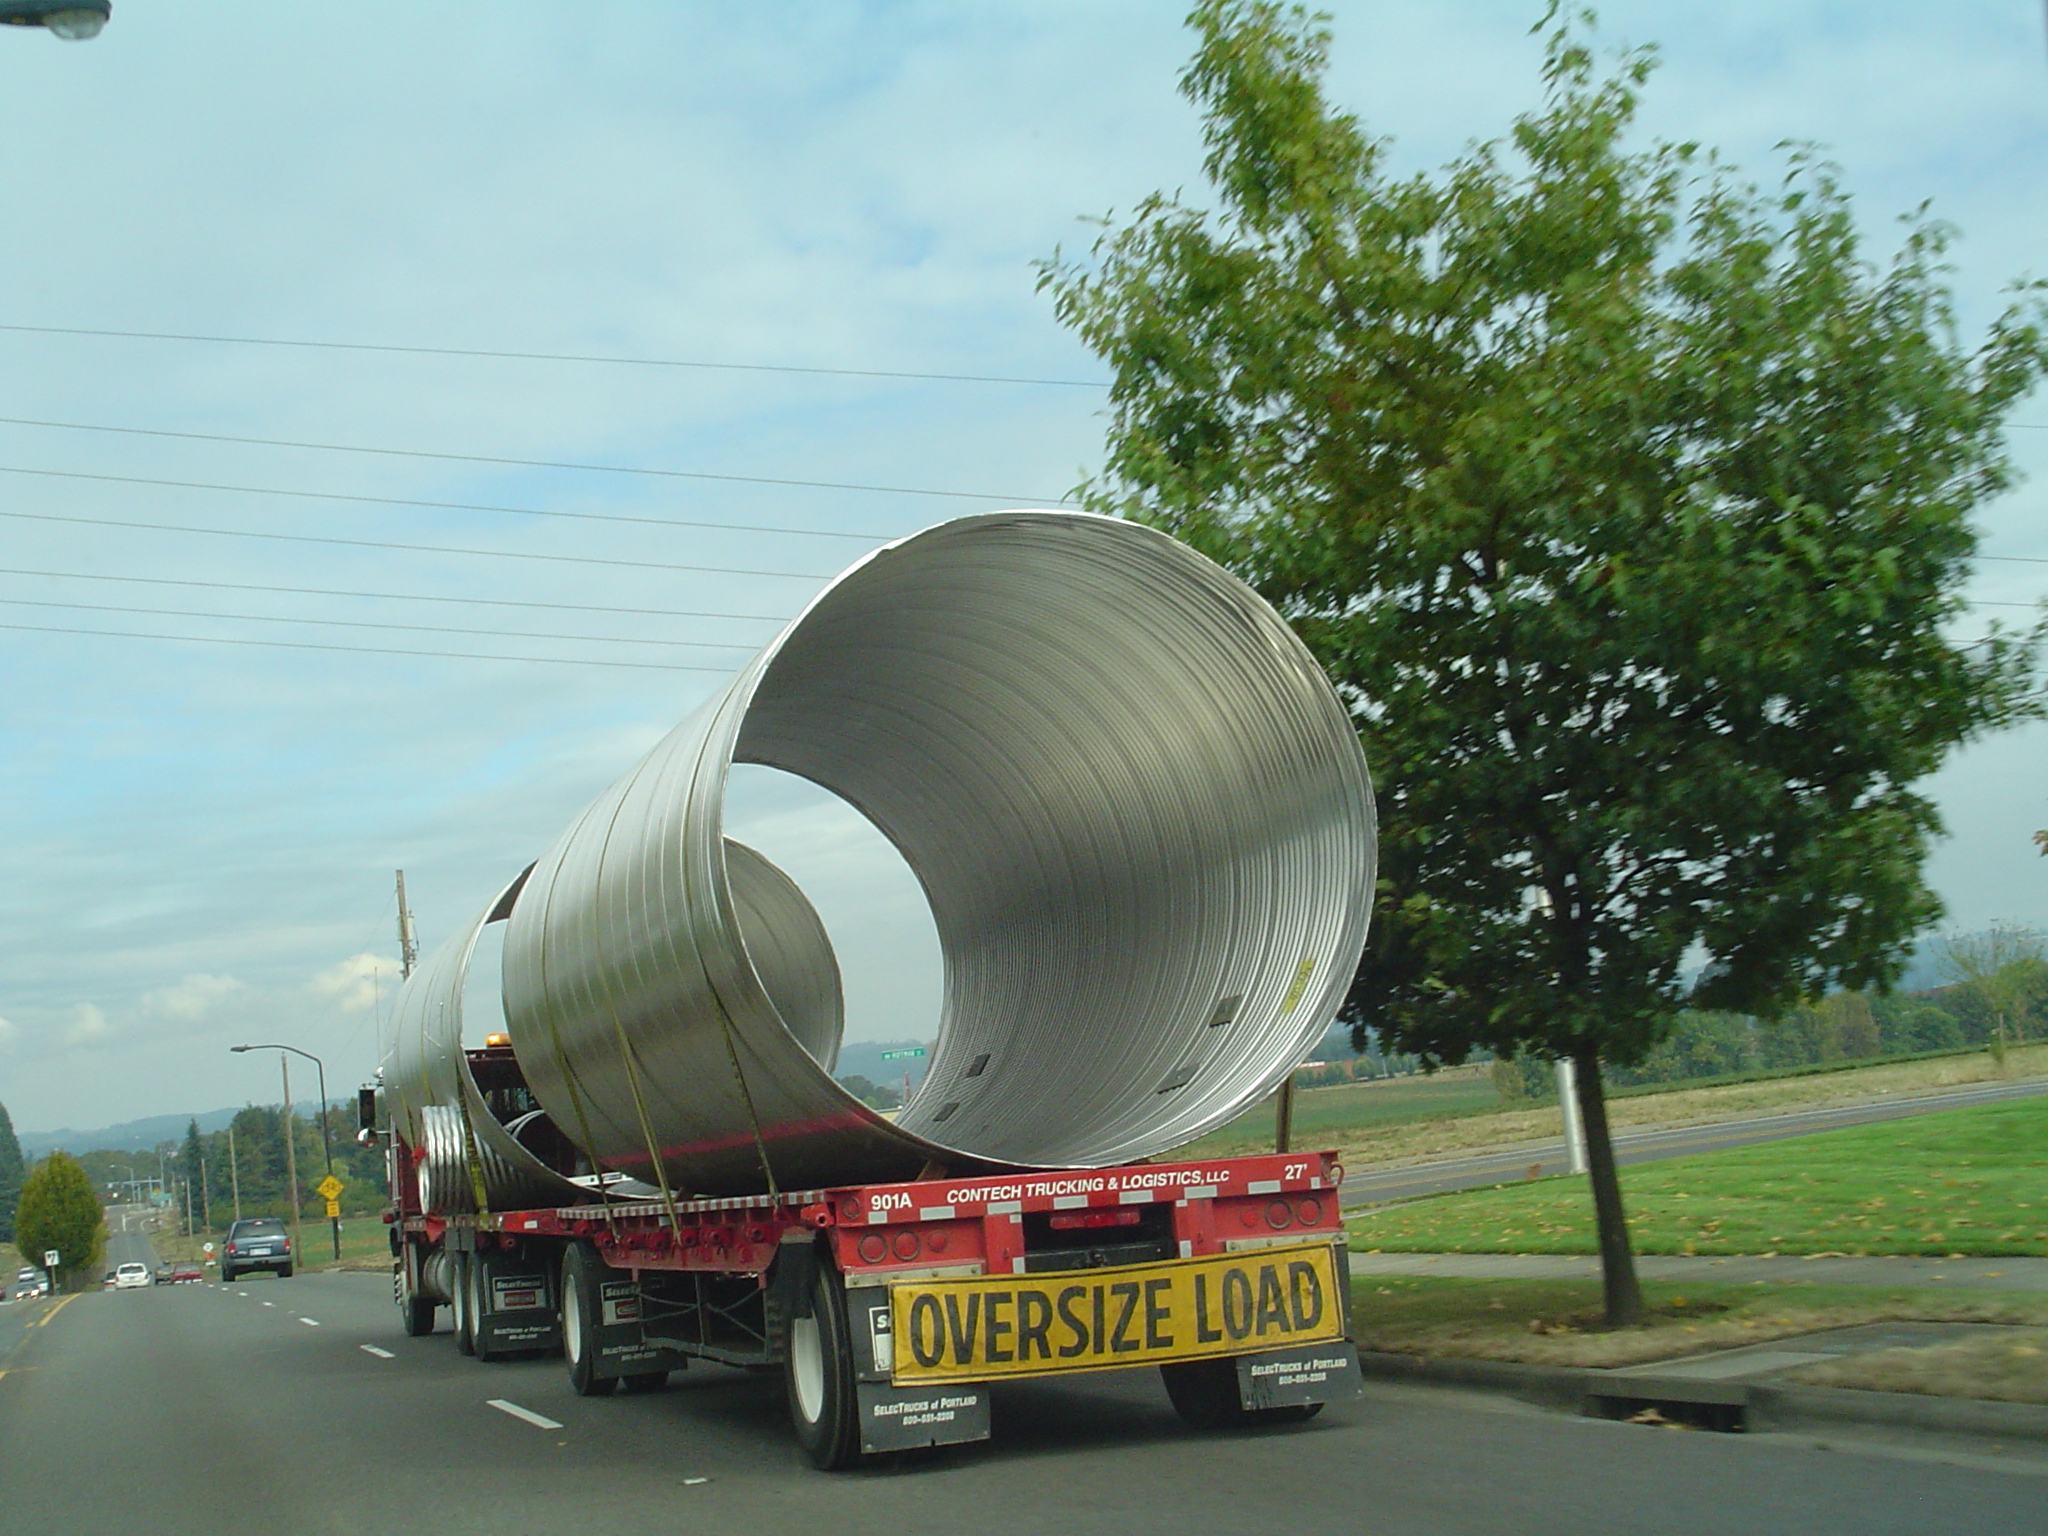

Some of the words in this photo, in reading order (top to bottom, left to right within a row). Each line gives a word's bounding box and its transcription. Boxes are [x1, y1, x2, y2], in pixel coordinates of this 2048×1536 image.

[1285, 1163, 1308, 1180] 27'
[947, 1184, 1022, 1204] CONTECH
[1026, 1177, 1104, 1197] TRUCKING
[1107, 1177, 1118, 1190] &
[1122, 1170, 1204, 1189] LOGISTICS,
[1206, 1170, 1230, 1182] LLC
[871, 1192, 912, 1210] 901A
[910, 1277, 1173, 1369] OVERSIZE
[1193, 1260, 1323, 1344] LOAD
